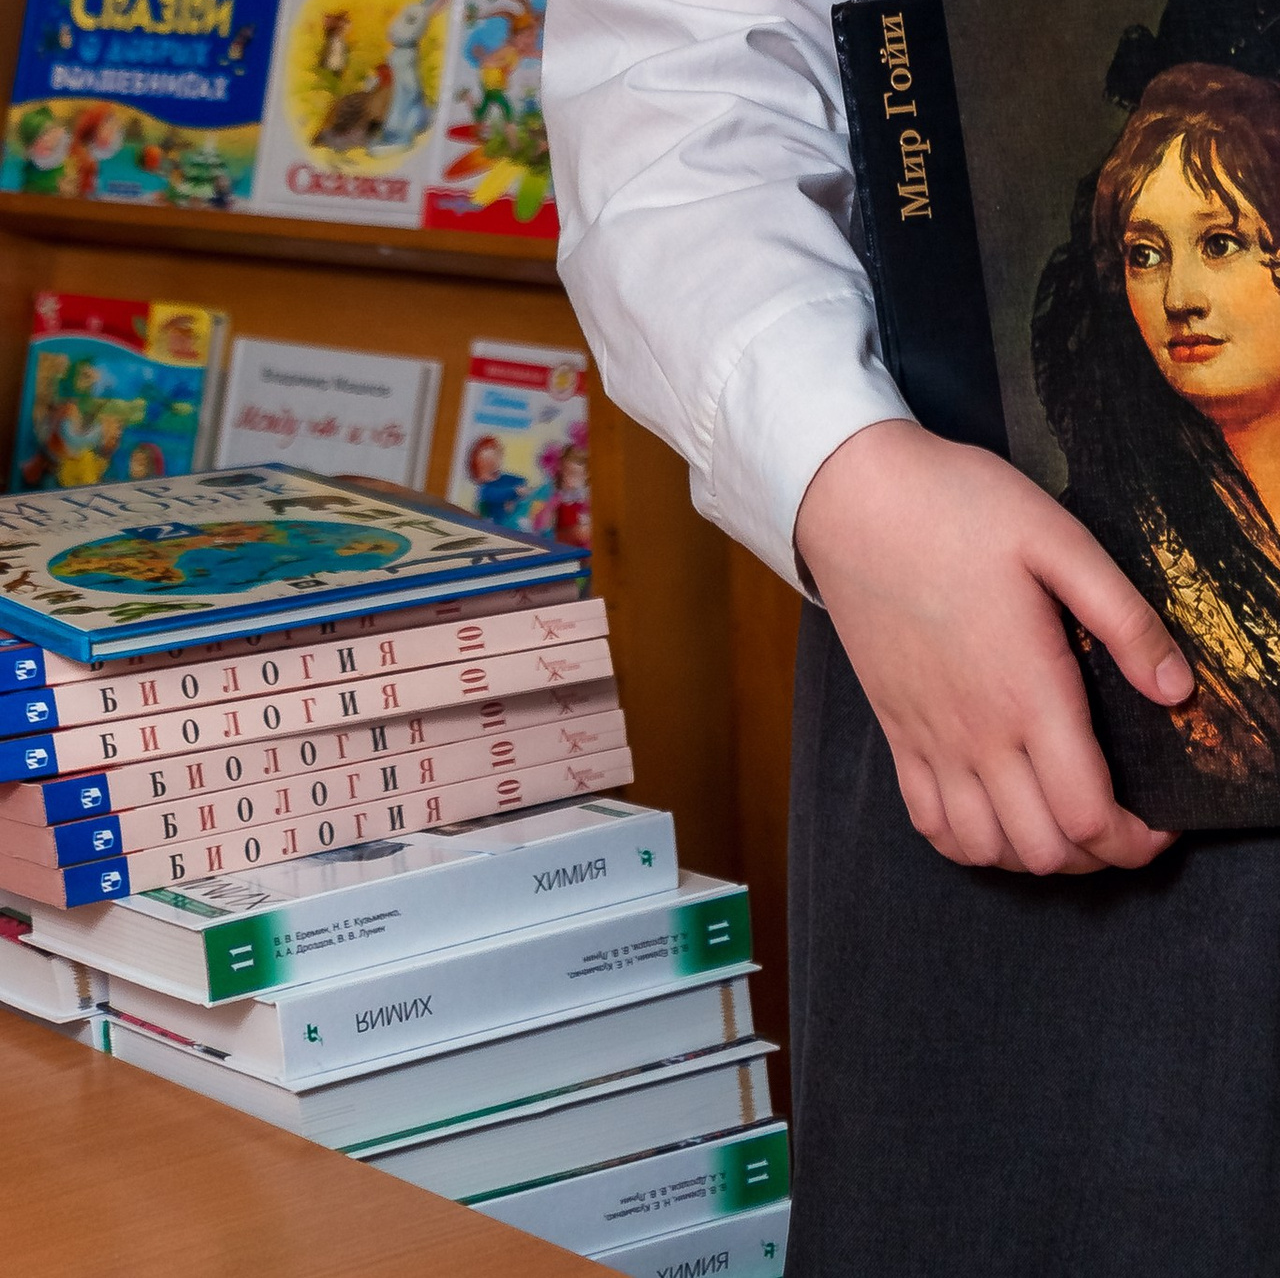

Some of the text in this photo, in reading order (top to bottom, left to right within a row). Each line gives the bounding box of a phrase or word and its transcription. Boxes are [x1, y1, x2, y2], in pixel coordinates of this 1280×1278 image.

[880, 12, 932, 221] Мир Гойи
[138, 525, 190, 539] 2
[100, 641, 397, 713] БИОЛОГИЯ
[457, 626, 485, 653] 10
[100, 683, 400, 759] БИОЛОГИЯ
[459, 668, 489, 694] 10
[150, 717, 425, 797] БИОЛОГИЯ
[480, 701, 506, 730] 10
[161, 741, 516, 839] БИОЛОГИЯ 10
[169, 797, 442, 880] БИОЛОГИЯ
[497, 779, 522, 806] 10
[533, 858, 607, 893] ХИМИЯ
[274, 936, 282, 946] В.
[285, 934, 292, 943] В.
[333, 922, 341, 931] Н.
[344, 919, 351, 928] Е.
[275, 949, 284, 958] А.
[286, 947, 293, 956] А.
[337, 934, 346, 943] В.
[348, 931, 357, 940] В.
[707, 920, 731, 945] 11
[229, 944, 254, 972] 11
[355, 995, 433, 1033] ХИМИЯ
[747, 1159, 769, 1184] 11
